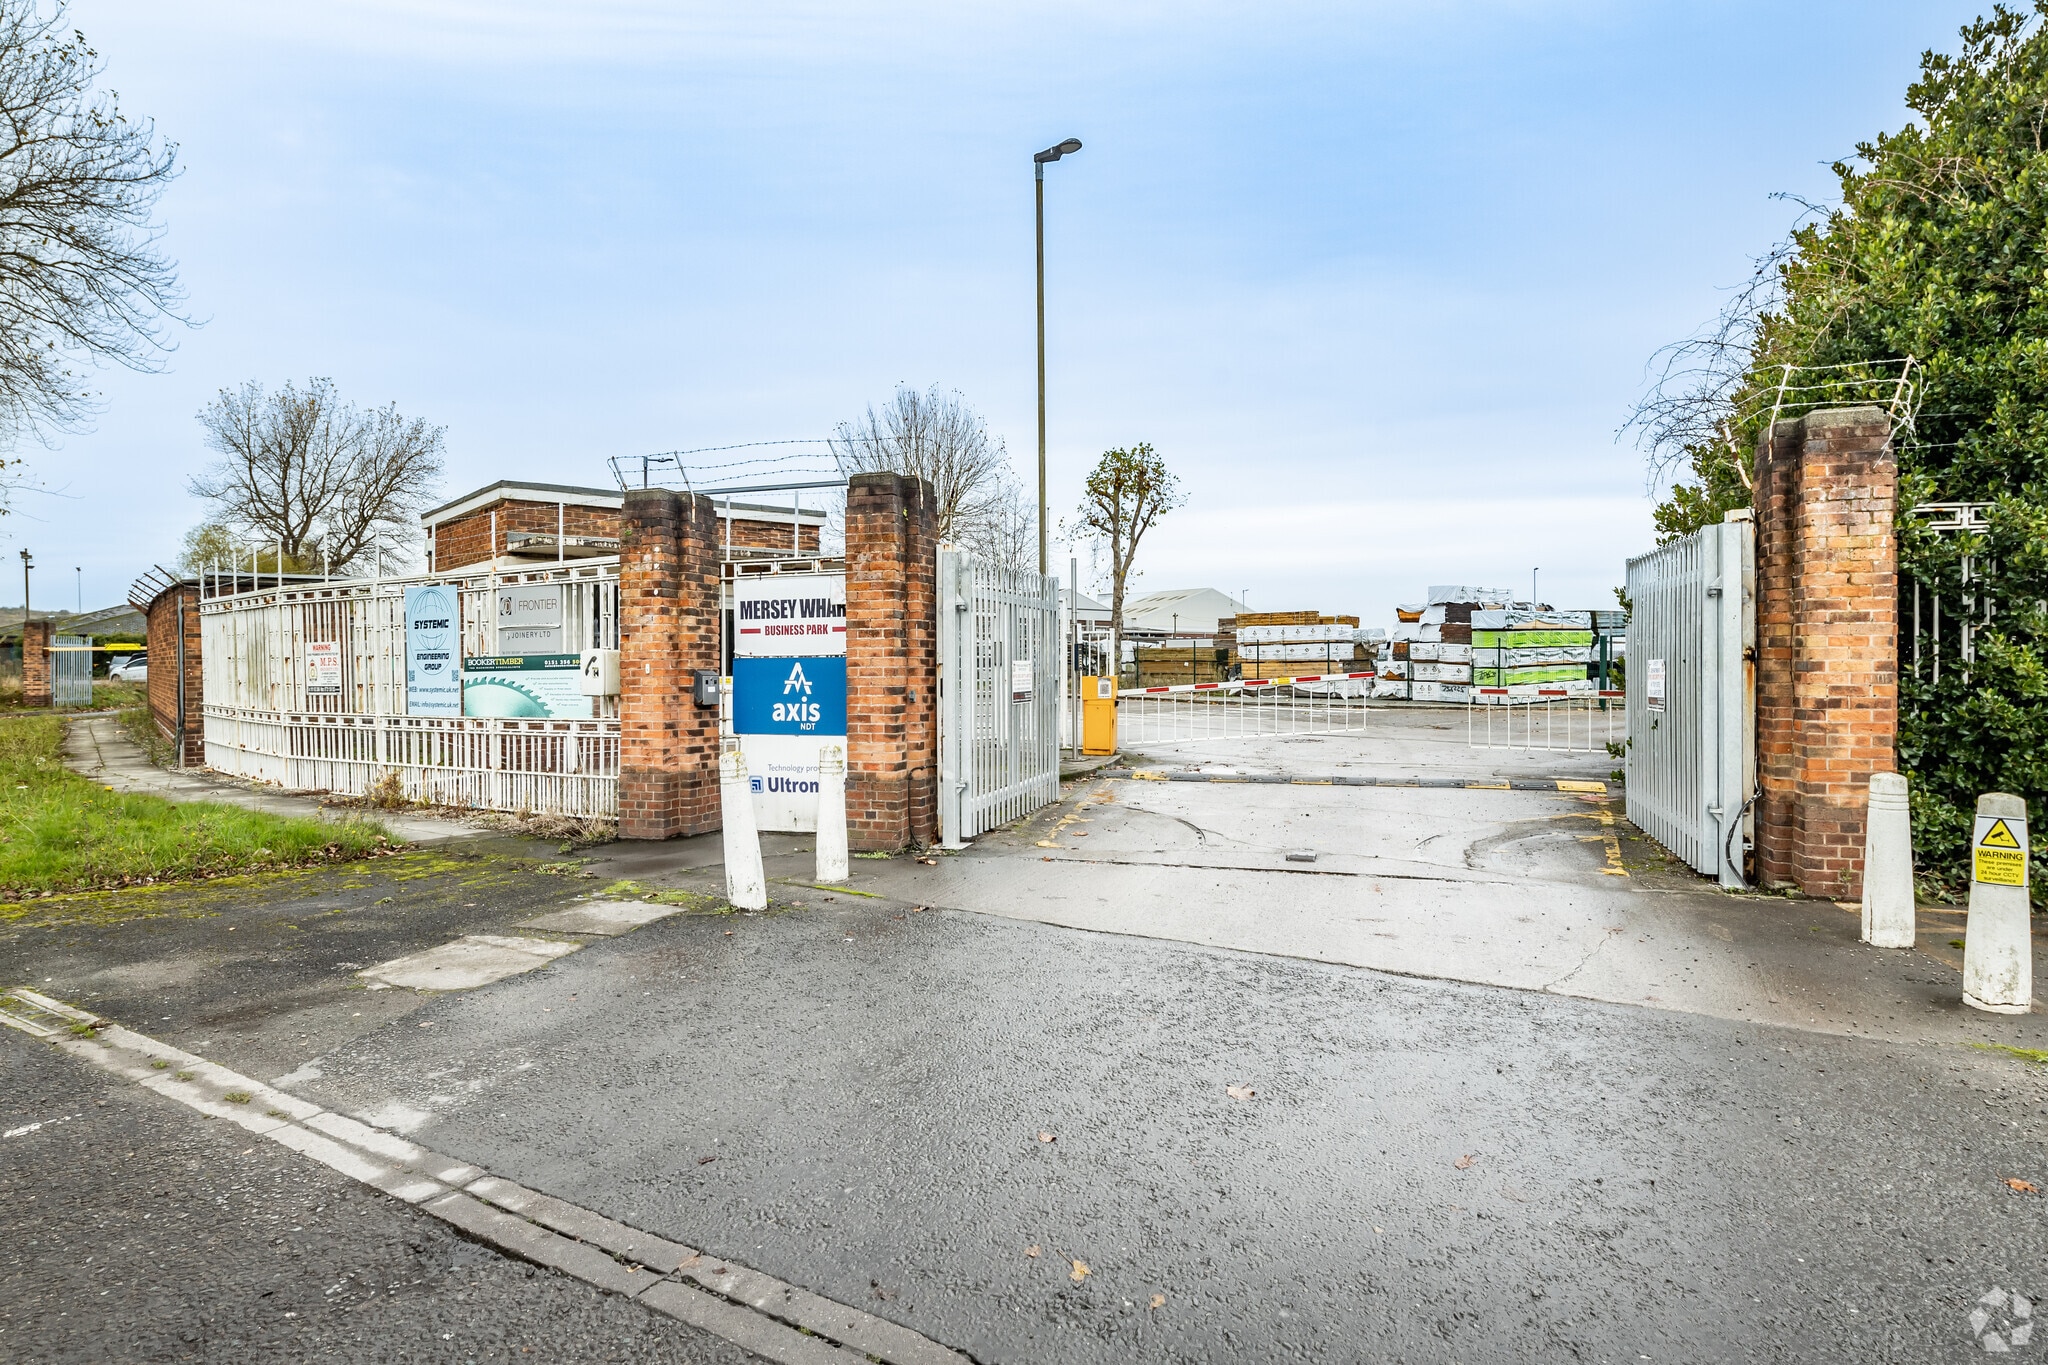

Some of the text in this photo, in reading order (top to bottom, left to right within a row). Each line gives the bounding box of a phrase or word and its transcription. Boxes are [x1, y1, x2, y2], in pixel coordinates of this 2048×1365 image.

[518, 598, 558, 611] FRONTIER
[740, 599, 797, 620] MERSEY
[414, 619, 450, 630] SYSTEMIC
[764, 624, 828, 636] BUSINESS PARK
[511, 630, 551, 639] JOINERY LTD
[416, 652, 450, 661] ENGINEERING
[467, 657, 524, 666] BOOKERTIMBER
[424, 663, 442, 671] GROUP
[772, 696, 821, 723] axis
[800, 722, 815, 731] NDT
[768, 764, 804, 773] Technology
[767, 777, 819, 793] Ultron
[1977, 850, 2023, 861] WARNING
